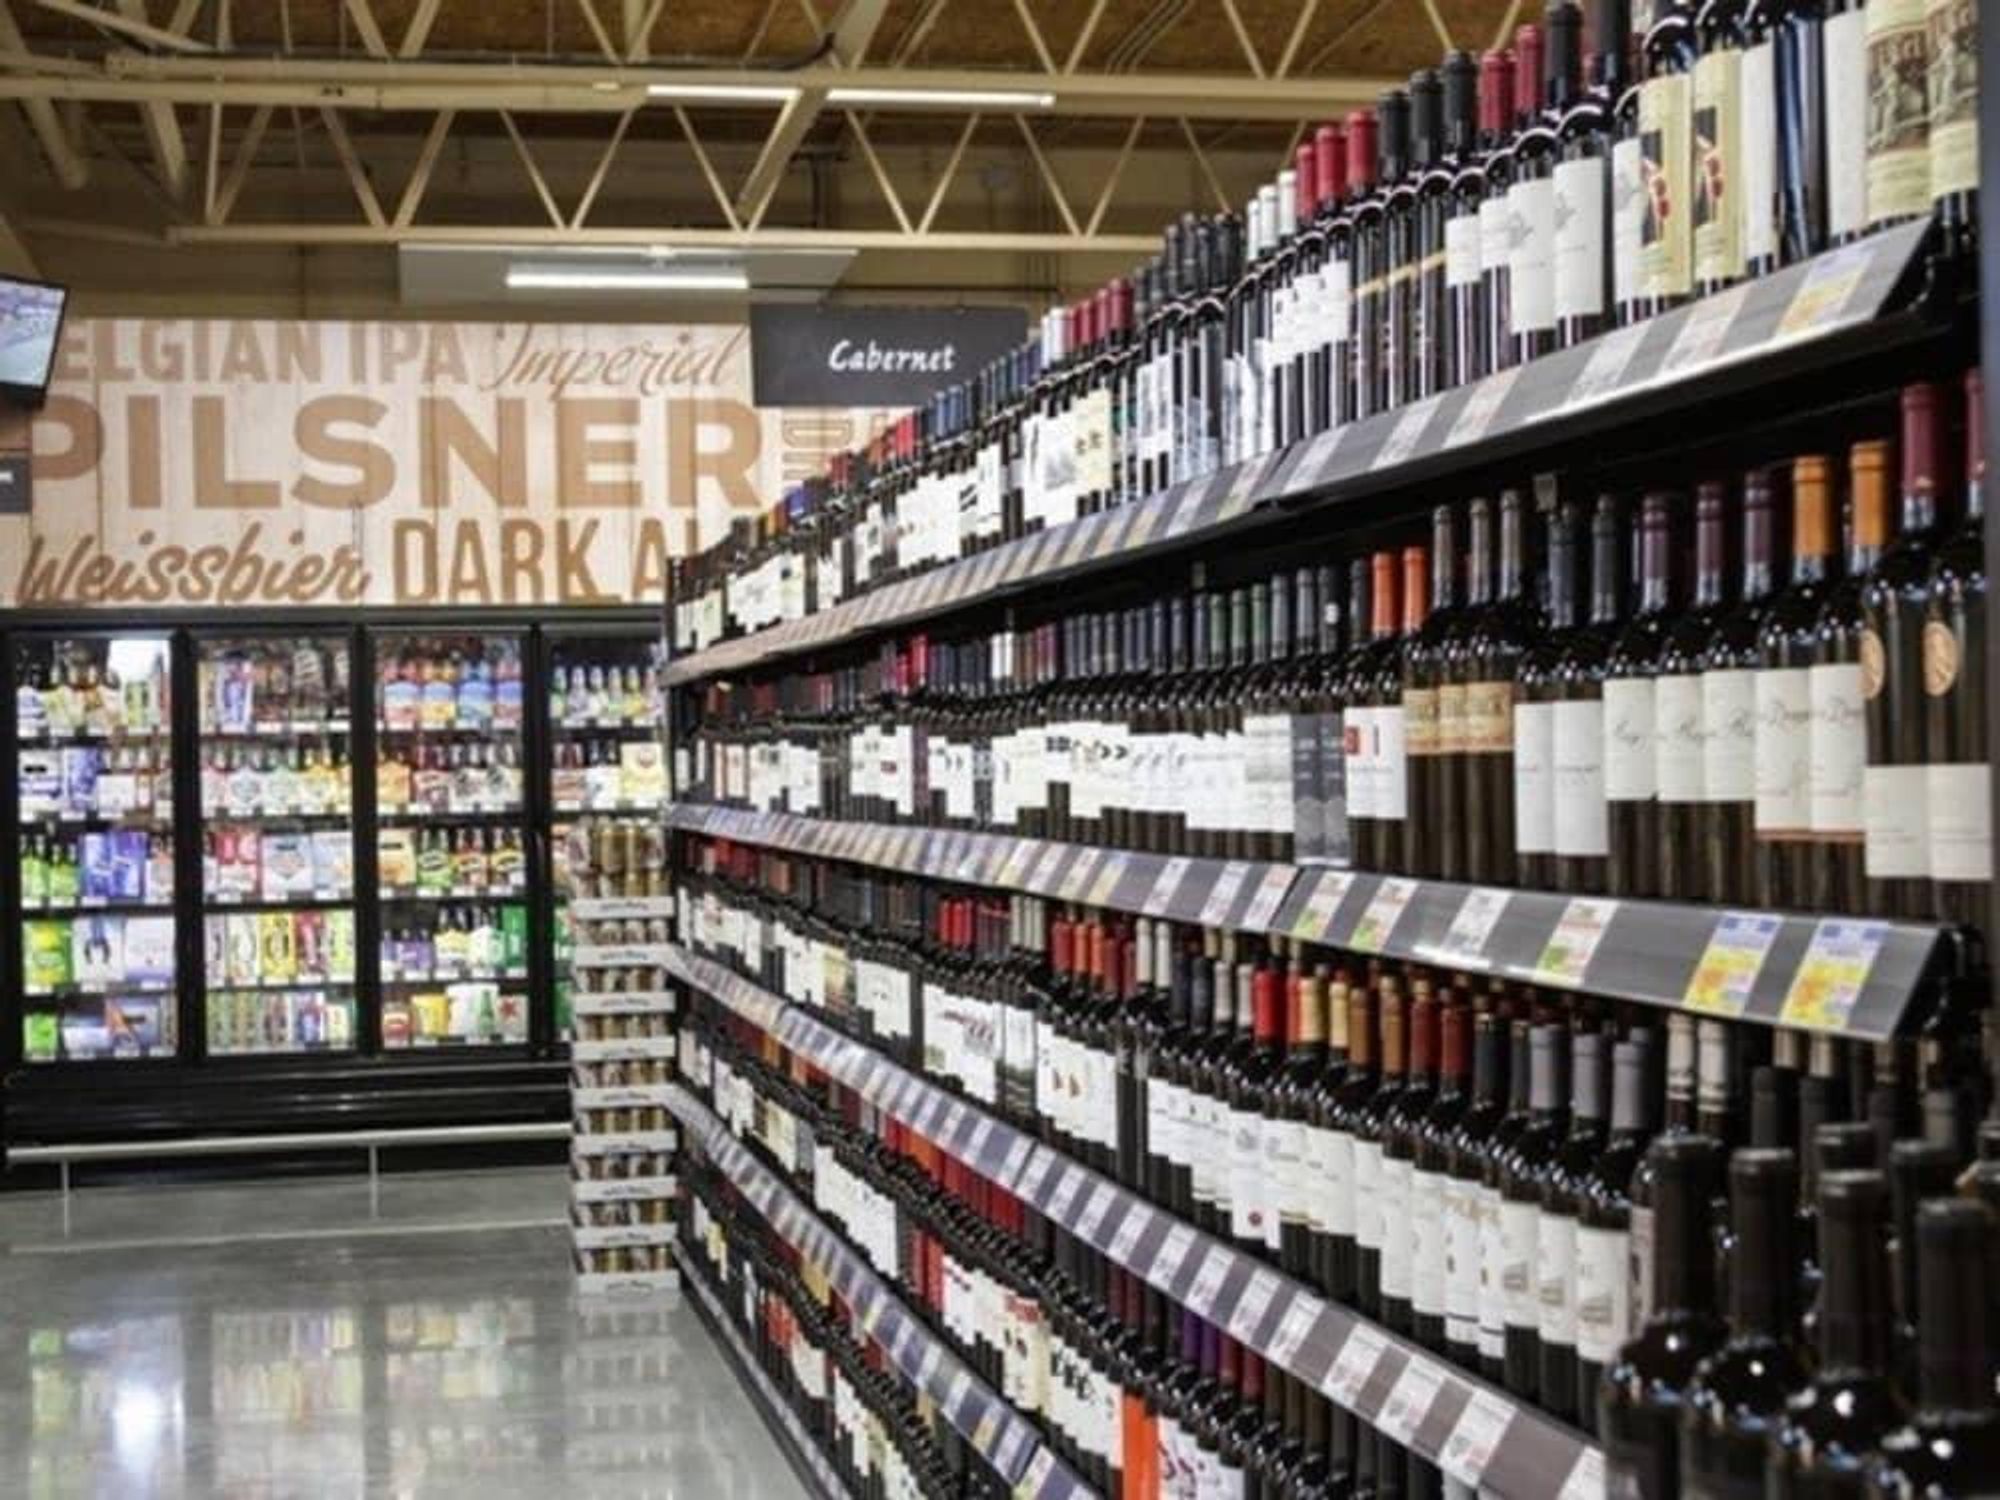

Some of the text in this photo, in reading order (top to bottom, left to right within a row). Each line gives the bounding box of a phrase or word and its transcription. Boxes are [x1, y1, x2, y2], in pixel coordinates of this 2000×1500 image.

[347, 321, 469, 382] IPA
[478, 322, 748, 400] Imperial
[828, 340, 955, 374] Cabernet
[8, 395, 763, 510] PILSNER
[16, 522, 371, 606] Weissbier
[392, 519, 621, 602] DARK
